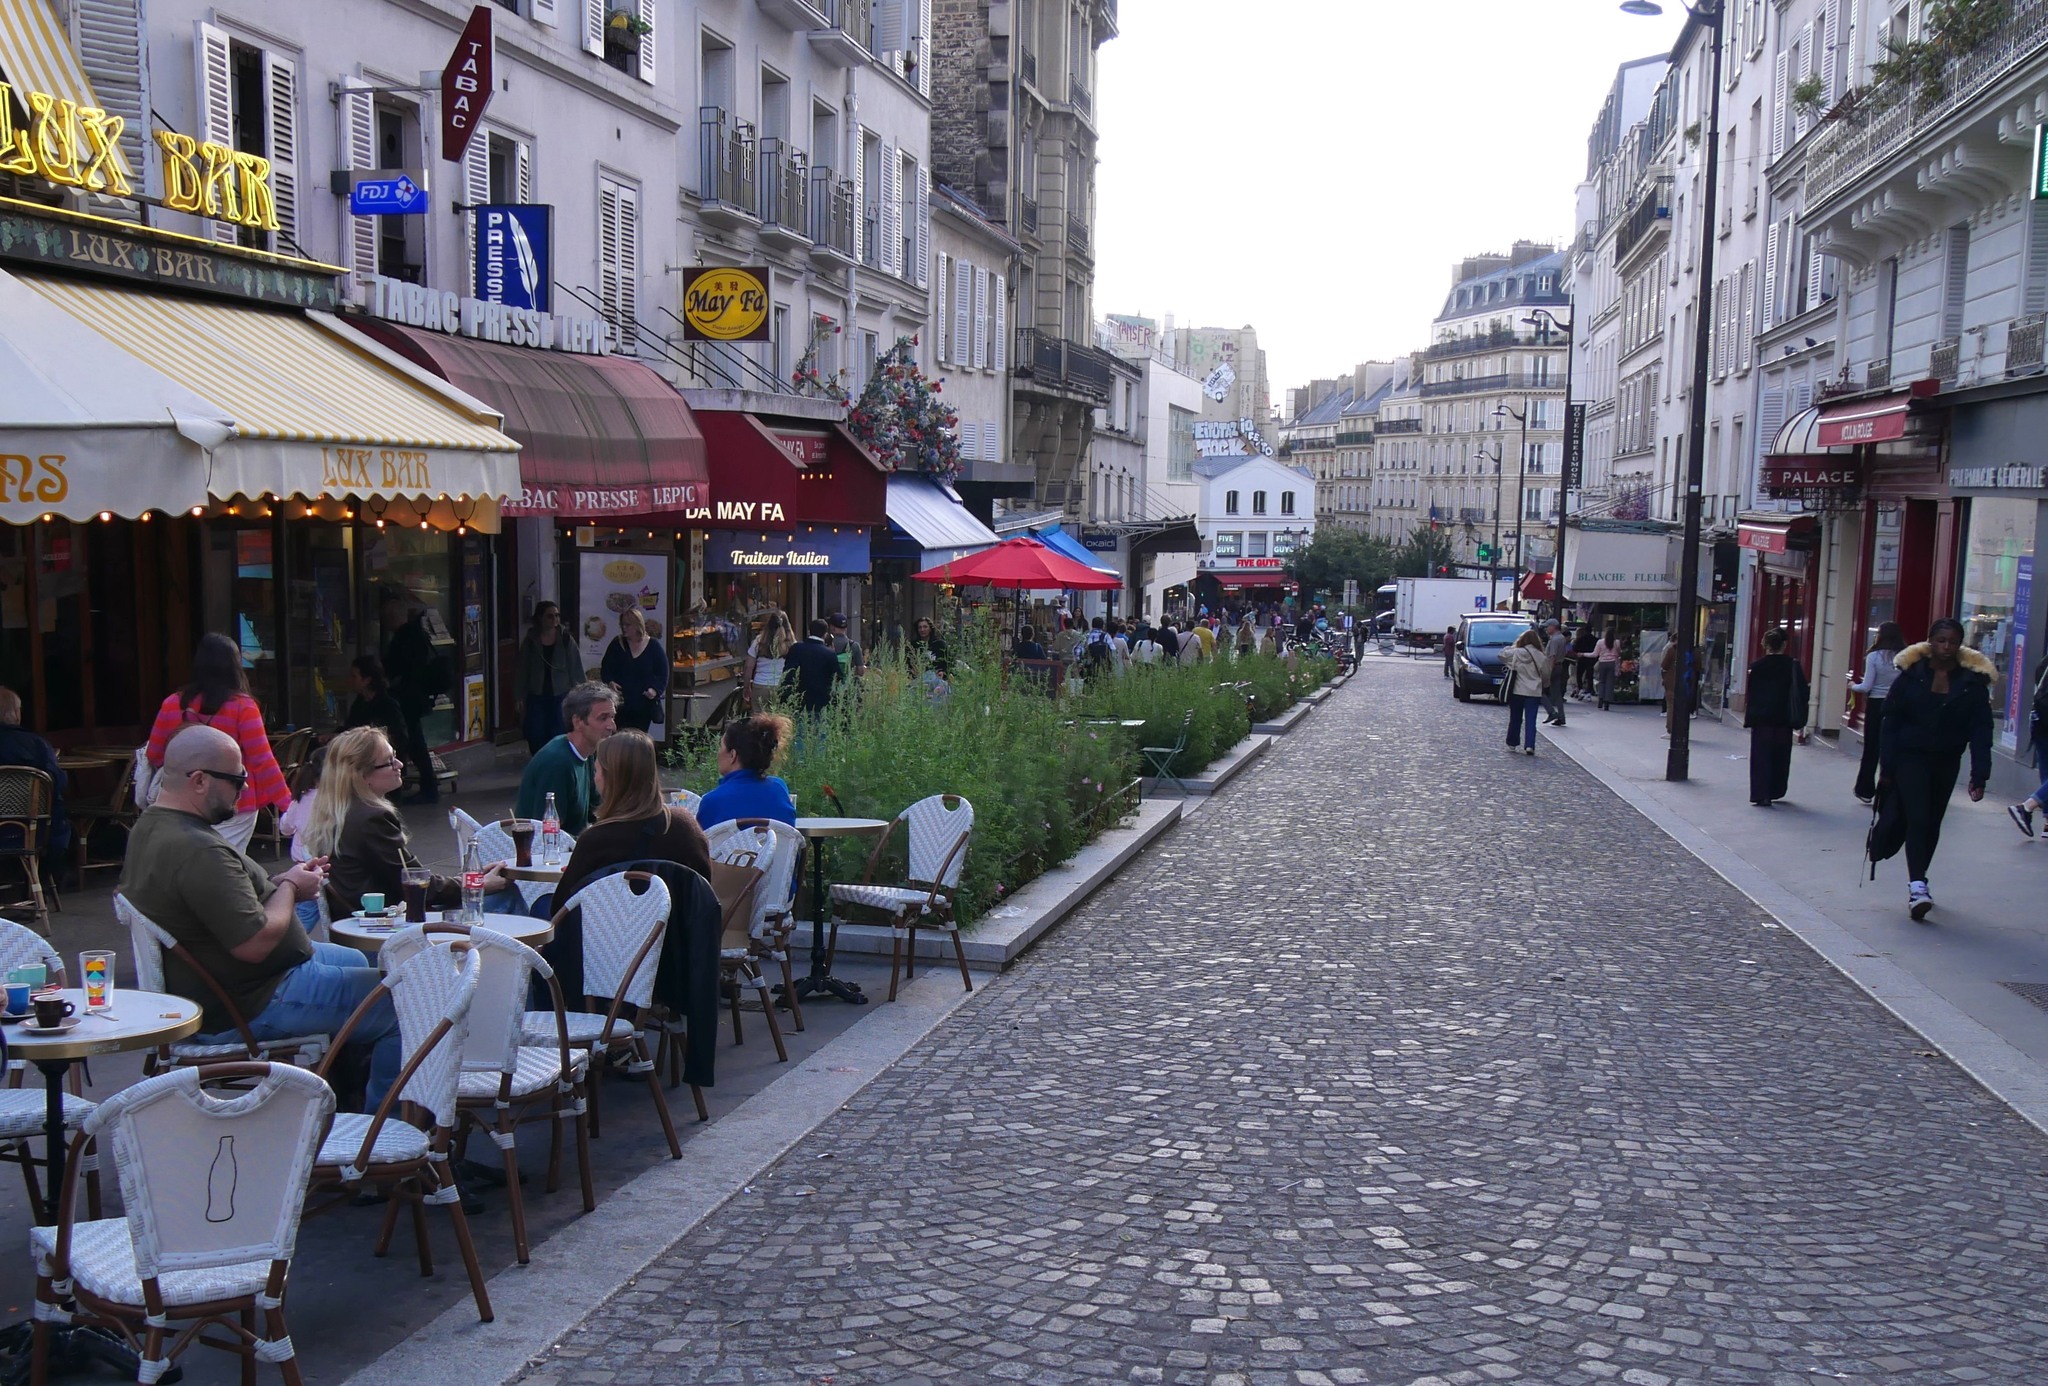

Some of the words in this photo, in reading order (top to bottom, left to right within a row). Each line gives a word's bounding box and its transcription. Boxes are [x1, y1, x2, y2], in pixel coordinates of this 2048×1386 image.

[452, 41, 482, 130] TABAC
[0, 80, 131, 197] LUX
[153, 129, 281, 231] BAR
[360, 185, 390, 200] FDJ
[69, 229, 135, 270] LUX
[151, 247, 217, 284] BAR
[366, 272, 459, 333] TABAC
[463, 298, 554, 349] PRESSE
[555, 315, 616, 357] LEPIC
[687, 288, 735, 324] May
[740, 289, 765, 313] Fa
[321, 447, 374, 488] LUX
[380, 450, 432, 489] BAR
[1782, 471, 1855, 484] PALACE
[574, 489, 640, 511] PRESSE
[652, 485, 695, 506] LEPIC
[716, 501, 757, 521] MAY
[761, 502, 785, 522] FA
[1085, 540, 1116, 548] okaidi
[1218, 535, 1234, 543] FIVE
[730, 550, 784, 566] Traiteur
[786, 550, 830, 567] Italien
[1216, 546, 1236, 554] GUYS
[1236, 558, 1255, 568] FIVE
[1256, 558, 1280, 568] GUYS
[1577, 572, 1627, 583] BLANCHE
